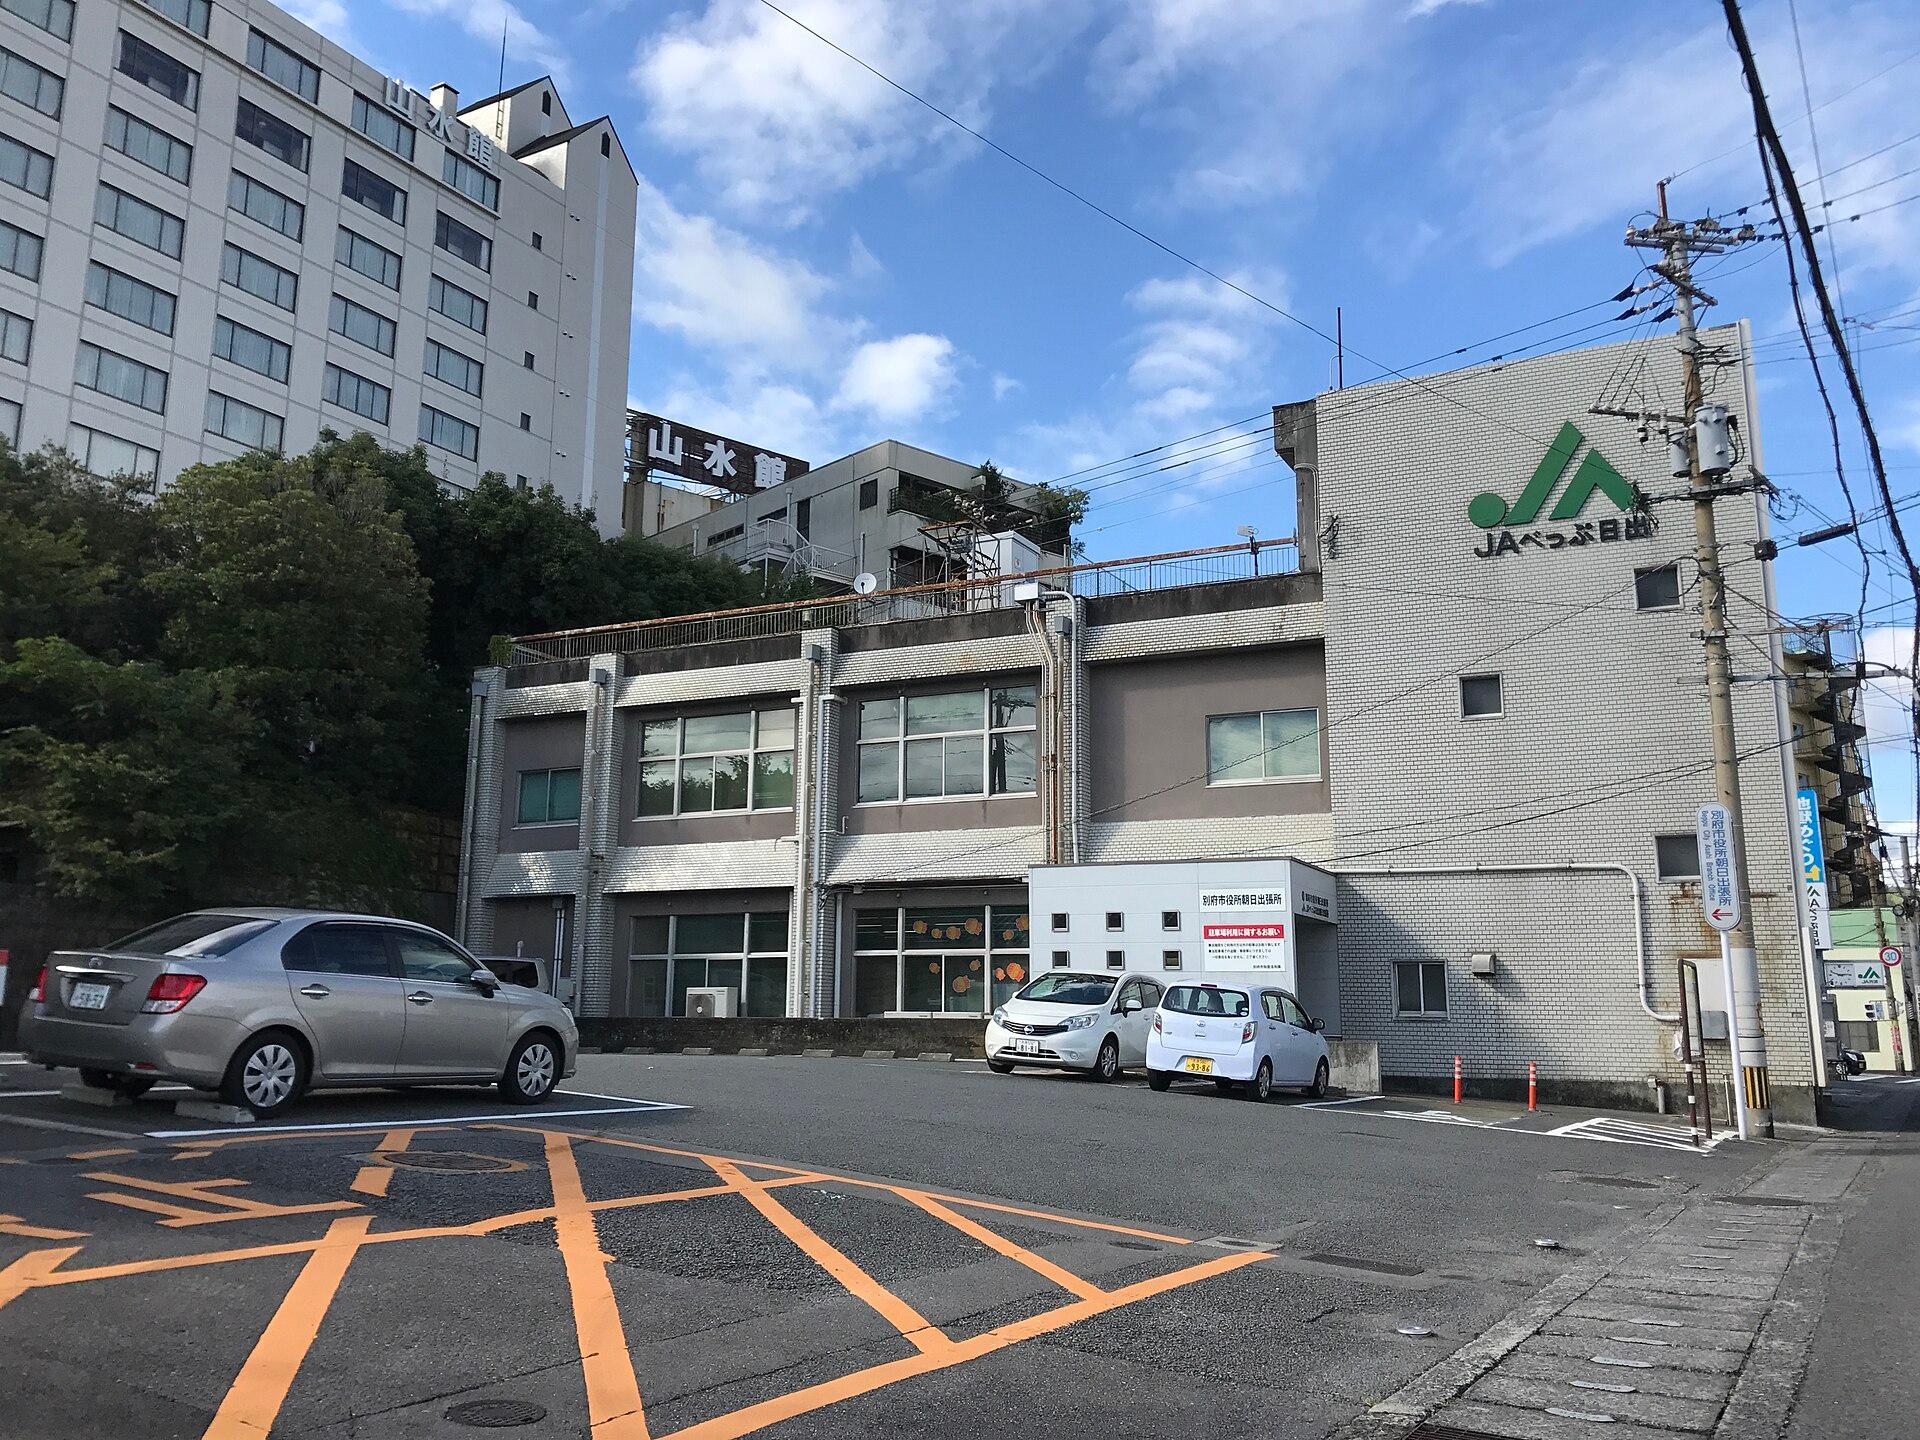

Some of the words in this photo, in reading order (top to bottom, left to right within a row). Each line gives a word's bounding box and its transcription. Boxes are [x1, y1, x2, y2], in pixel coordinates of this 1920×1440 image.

[385, 76, 493, 170] 山水館
[648, 423, 787, 489] 山水館
[1703, 829, 1711, 841] City
[1710, 810, 1732, 907] 別府市役所朝日出張所
[1706, 862, 1714, 881] Branch
[1202, 893, 1282, 906] 別府市役所朝日出張所
[1708, 884, 1716, 901] Office
[1884, 951, 1898, 961] 30
